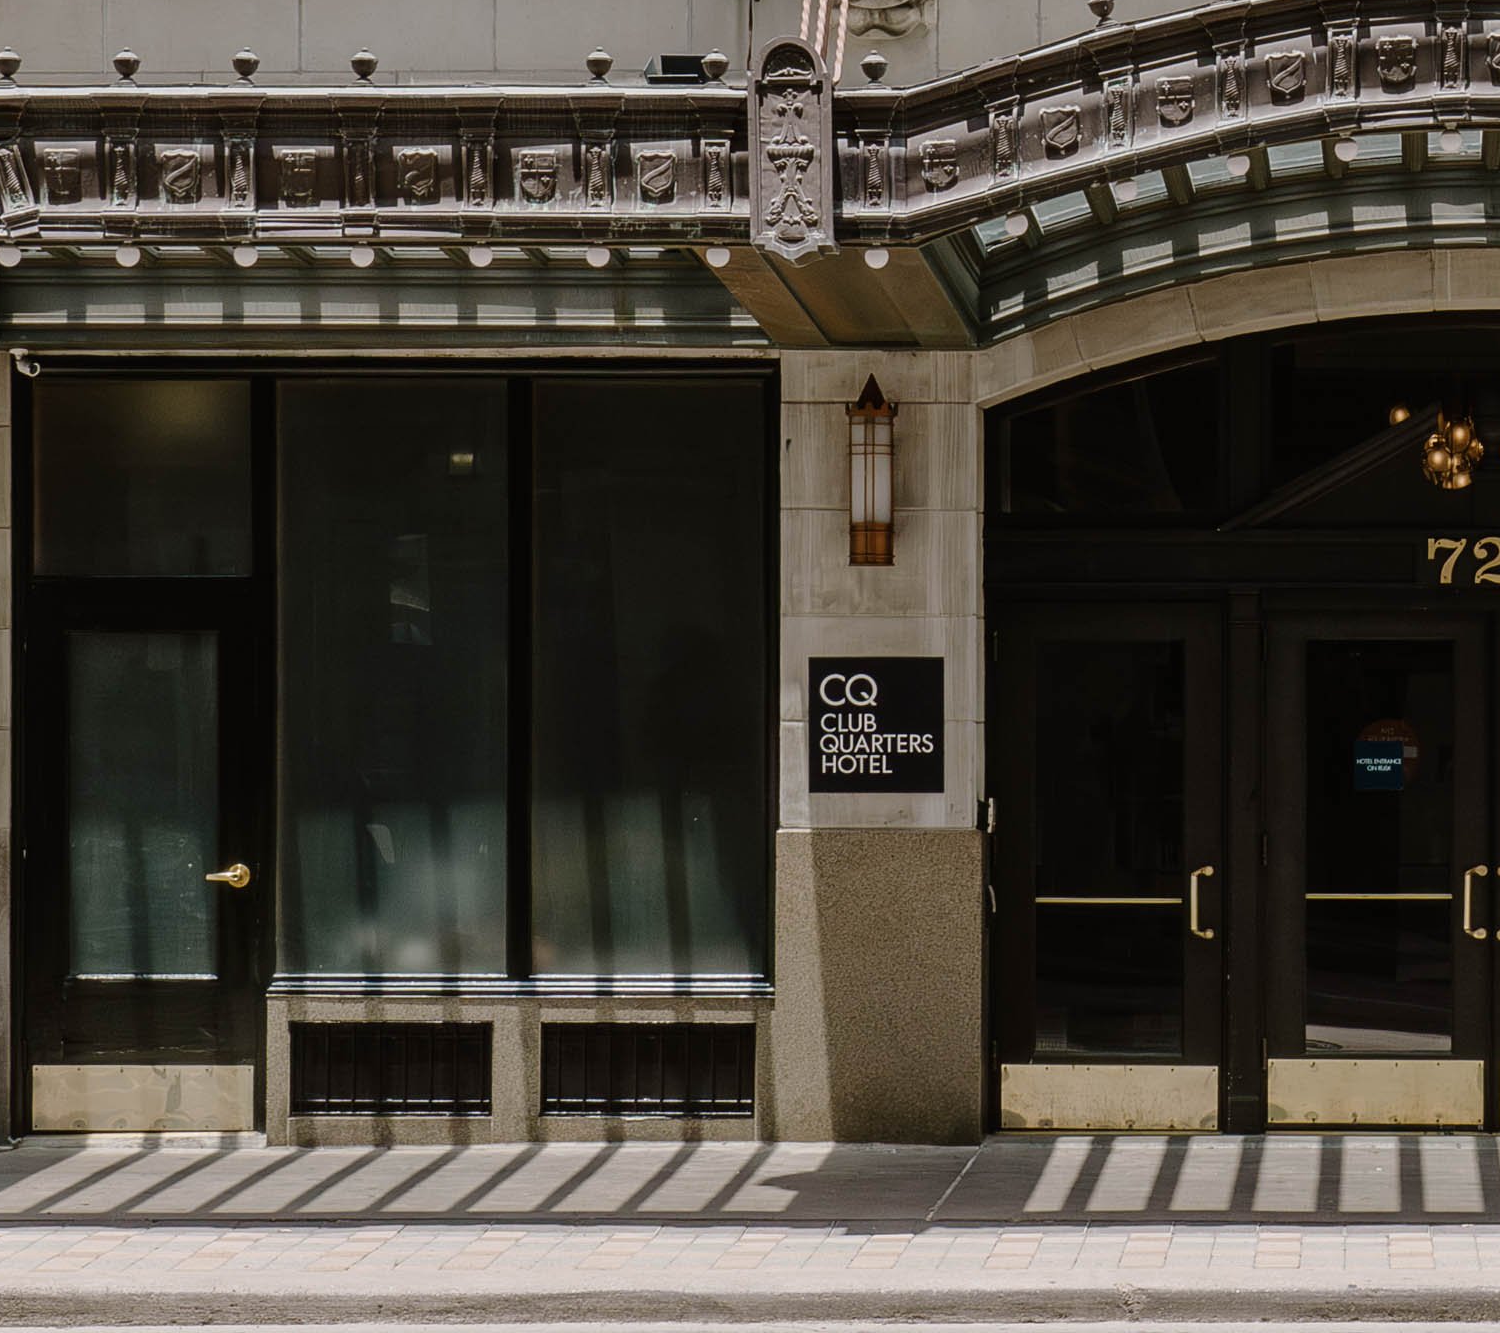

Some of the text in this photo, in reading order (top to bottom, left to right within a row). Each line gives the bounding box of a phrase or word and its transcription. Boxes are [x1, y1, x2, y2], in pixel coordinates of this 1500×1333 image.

[819, 673, 878, 706] CQ
[820, 713, 877, 732] CLUB
[819, 734, 934, 753] QUARTERS
[822, 754, 893, 774] HOTEL
